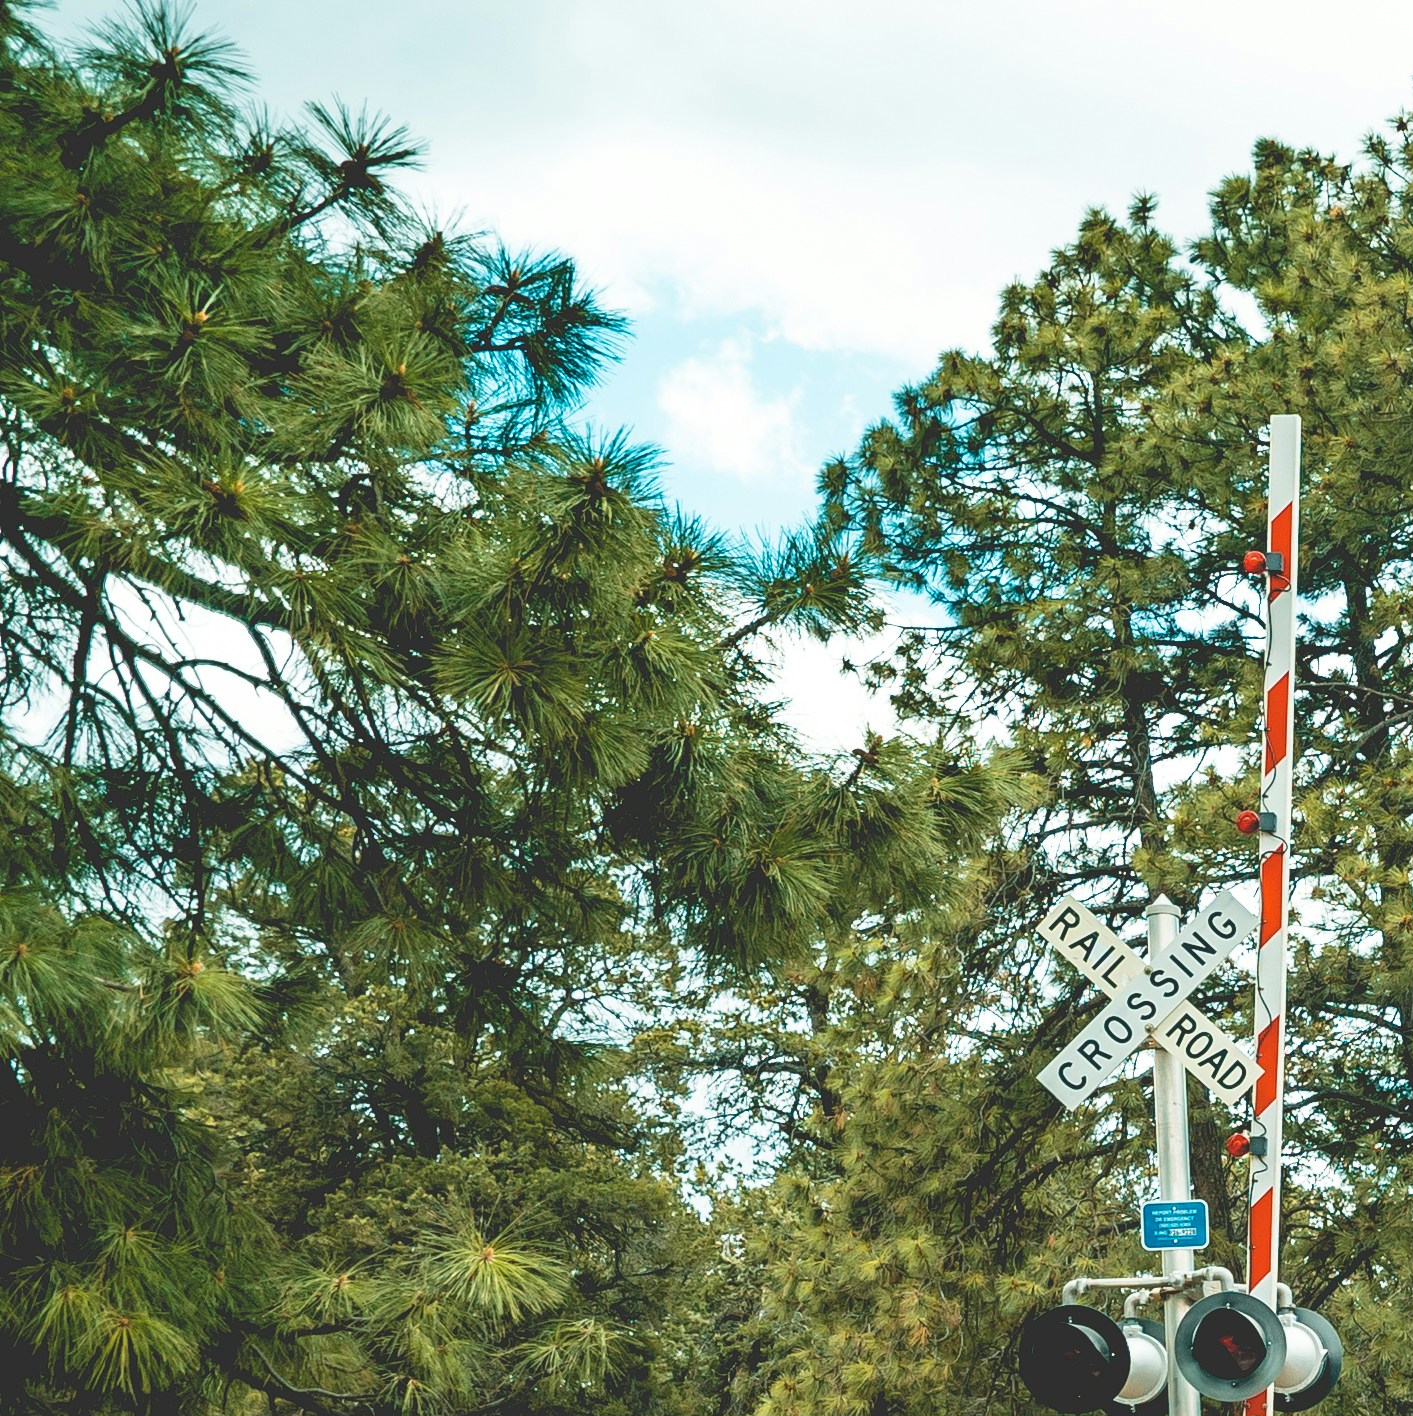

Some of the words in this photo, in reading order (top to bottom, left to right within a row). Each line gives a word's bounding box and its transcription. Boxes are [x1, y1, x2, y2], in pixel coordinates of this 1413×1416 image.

[1048, 906, 1128, 988] RAIL
[1165, 1013, 1247, 1092] ROAD
[1058, 911, 1236, 1091] CROSSING
